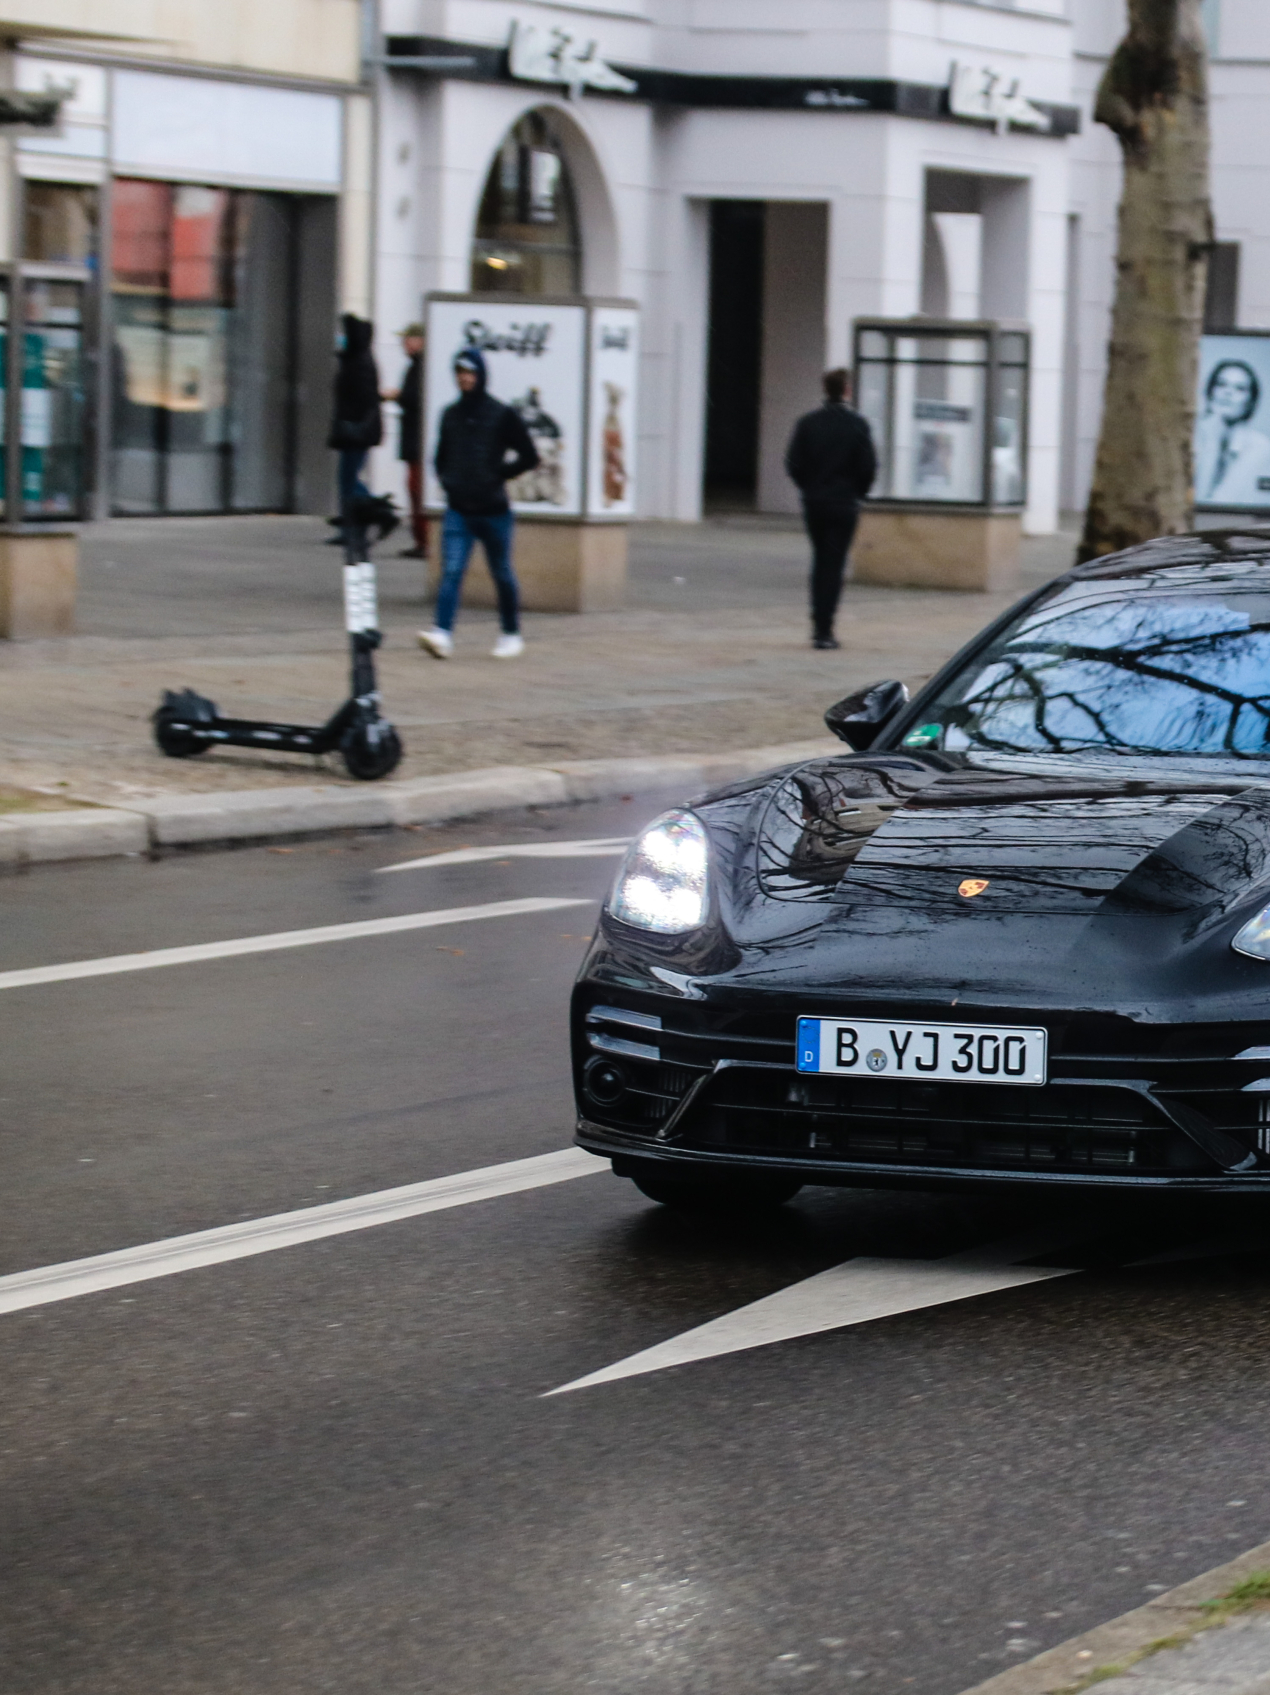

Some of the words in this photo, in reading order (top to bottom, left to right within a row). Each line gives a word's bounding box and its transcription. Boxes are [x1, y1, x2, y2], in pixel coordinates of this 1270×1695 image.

[804, 1051, 814, 1062] D
[836, 1027, 859, 1067] B
[889, 1030, 939, 1071] YJ
[951, 1033, 1026, 1075] 300
